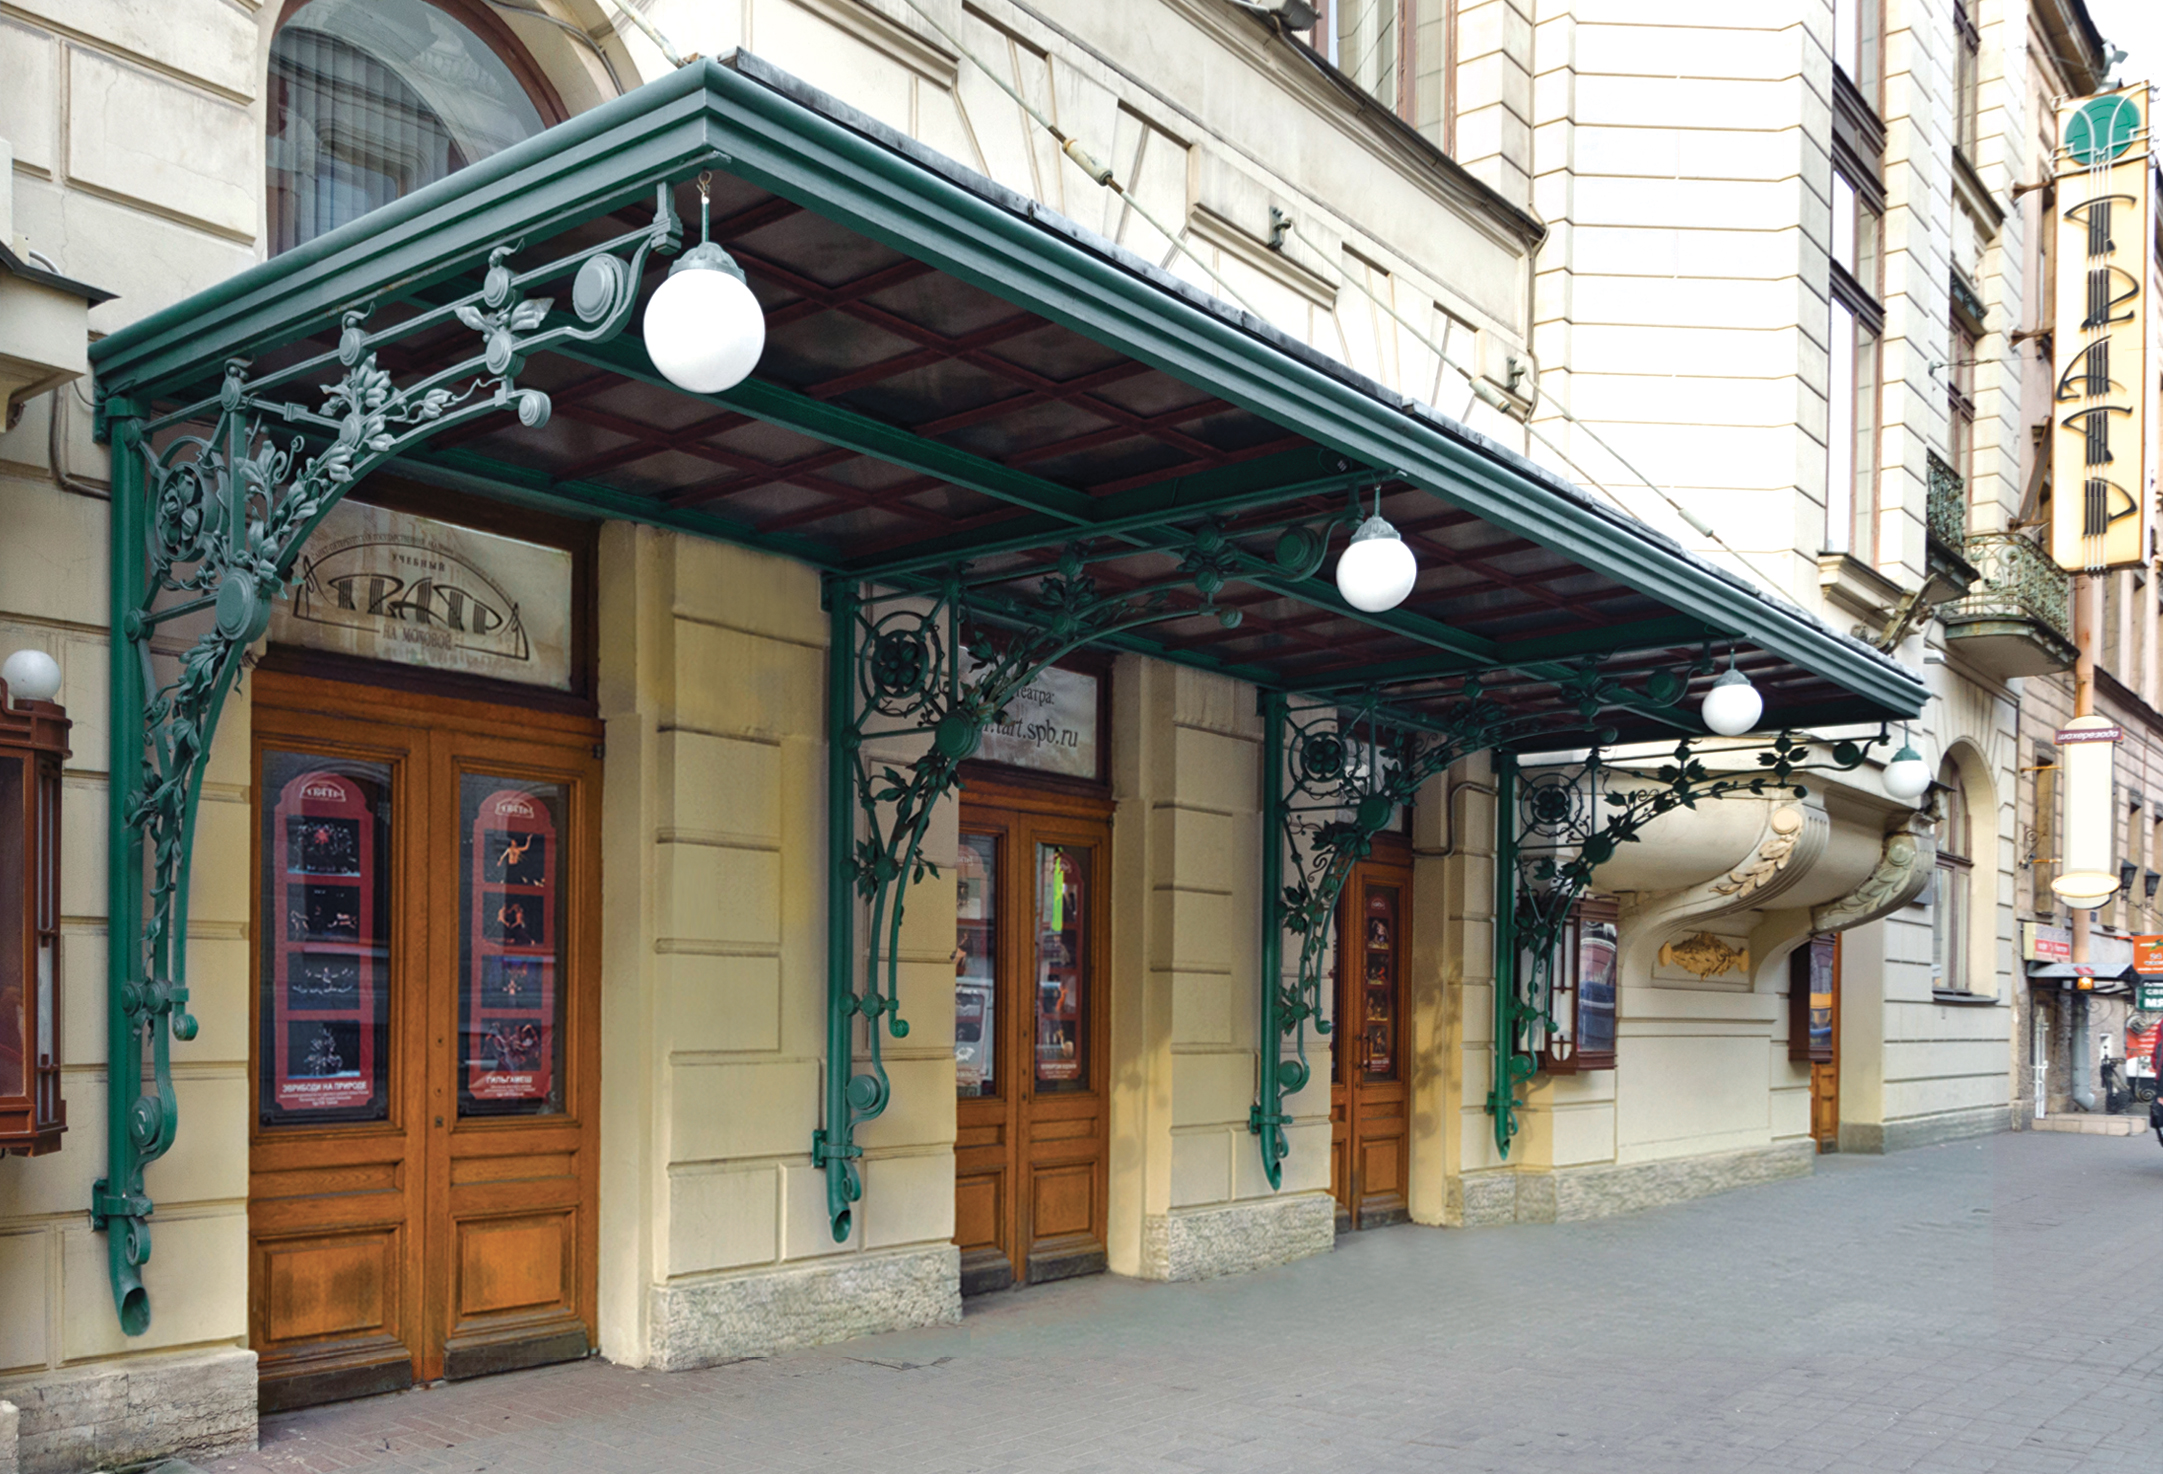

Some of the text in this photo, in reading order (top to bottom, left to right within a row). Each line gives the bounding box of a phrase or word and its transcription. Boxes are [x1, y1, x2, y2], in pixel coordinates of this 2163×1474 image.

[391, 552, 446, 573] УЧЕБНЫЙ
[382, 624, 397, 640] НА
[2057, 729, 2119, 741] шахерезада
[2149, 952, 2162, 961] 24
[485, 1075, 533, 1084] ГИЛЬГАМЕШ
[322, 1082, 333, 1091] НА
[333, 1081, 367, 1090] ПРИРОДЕ
